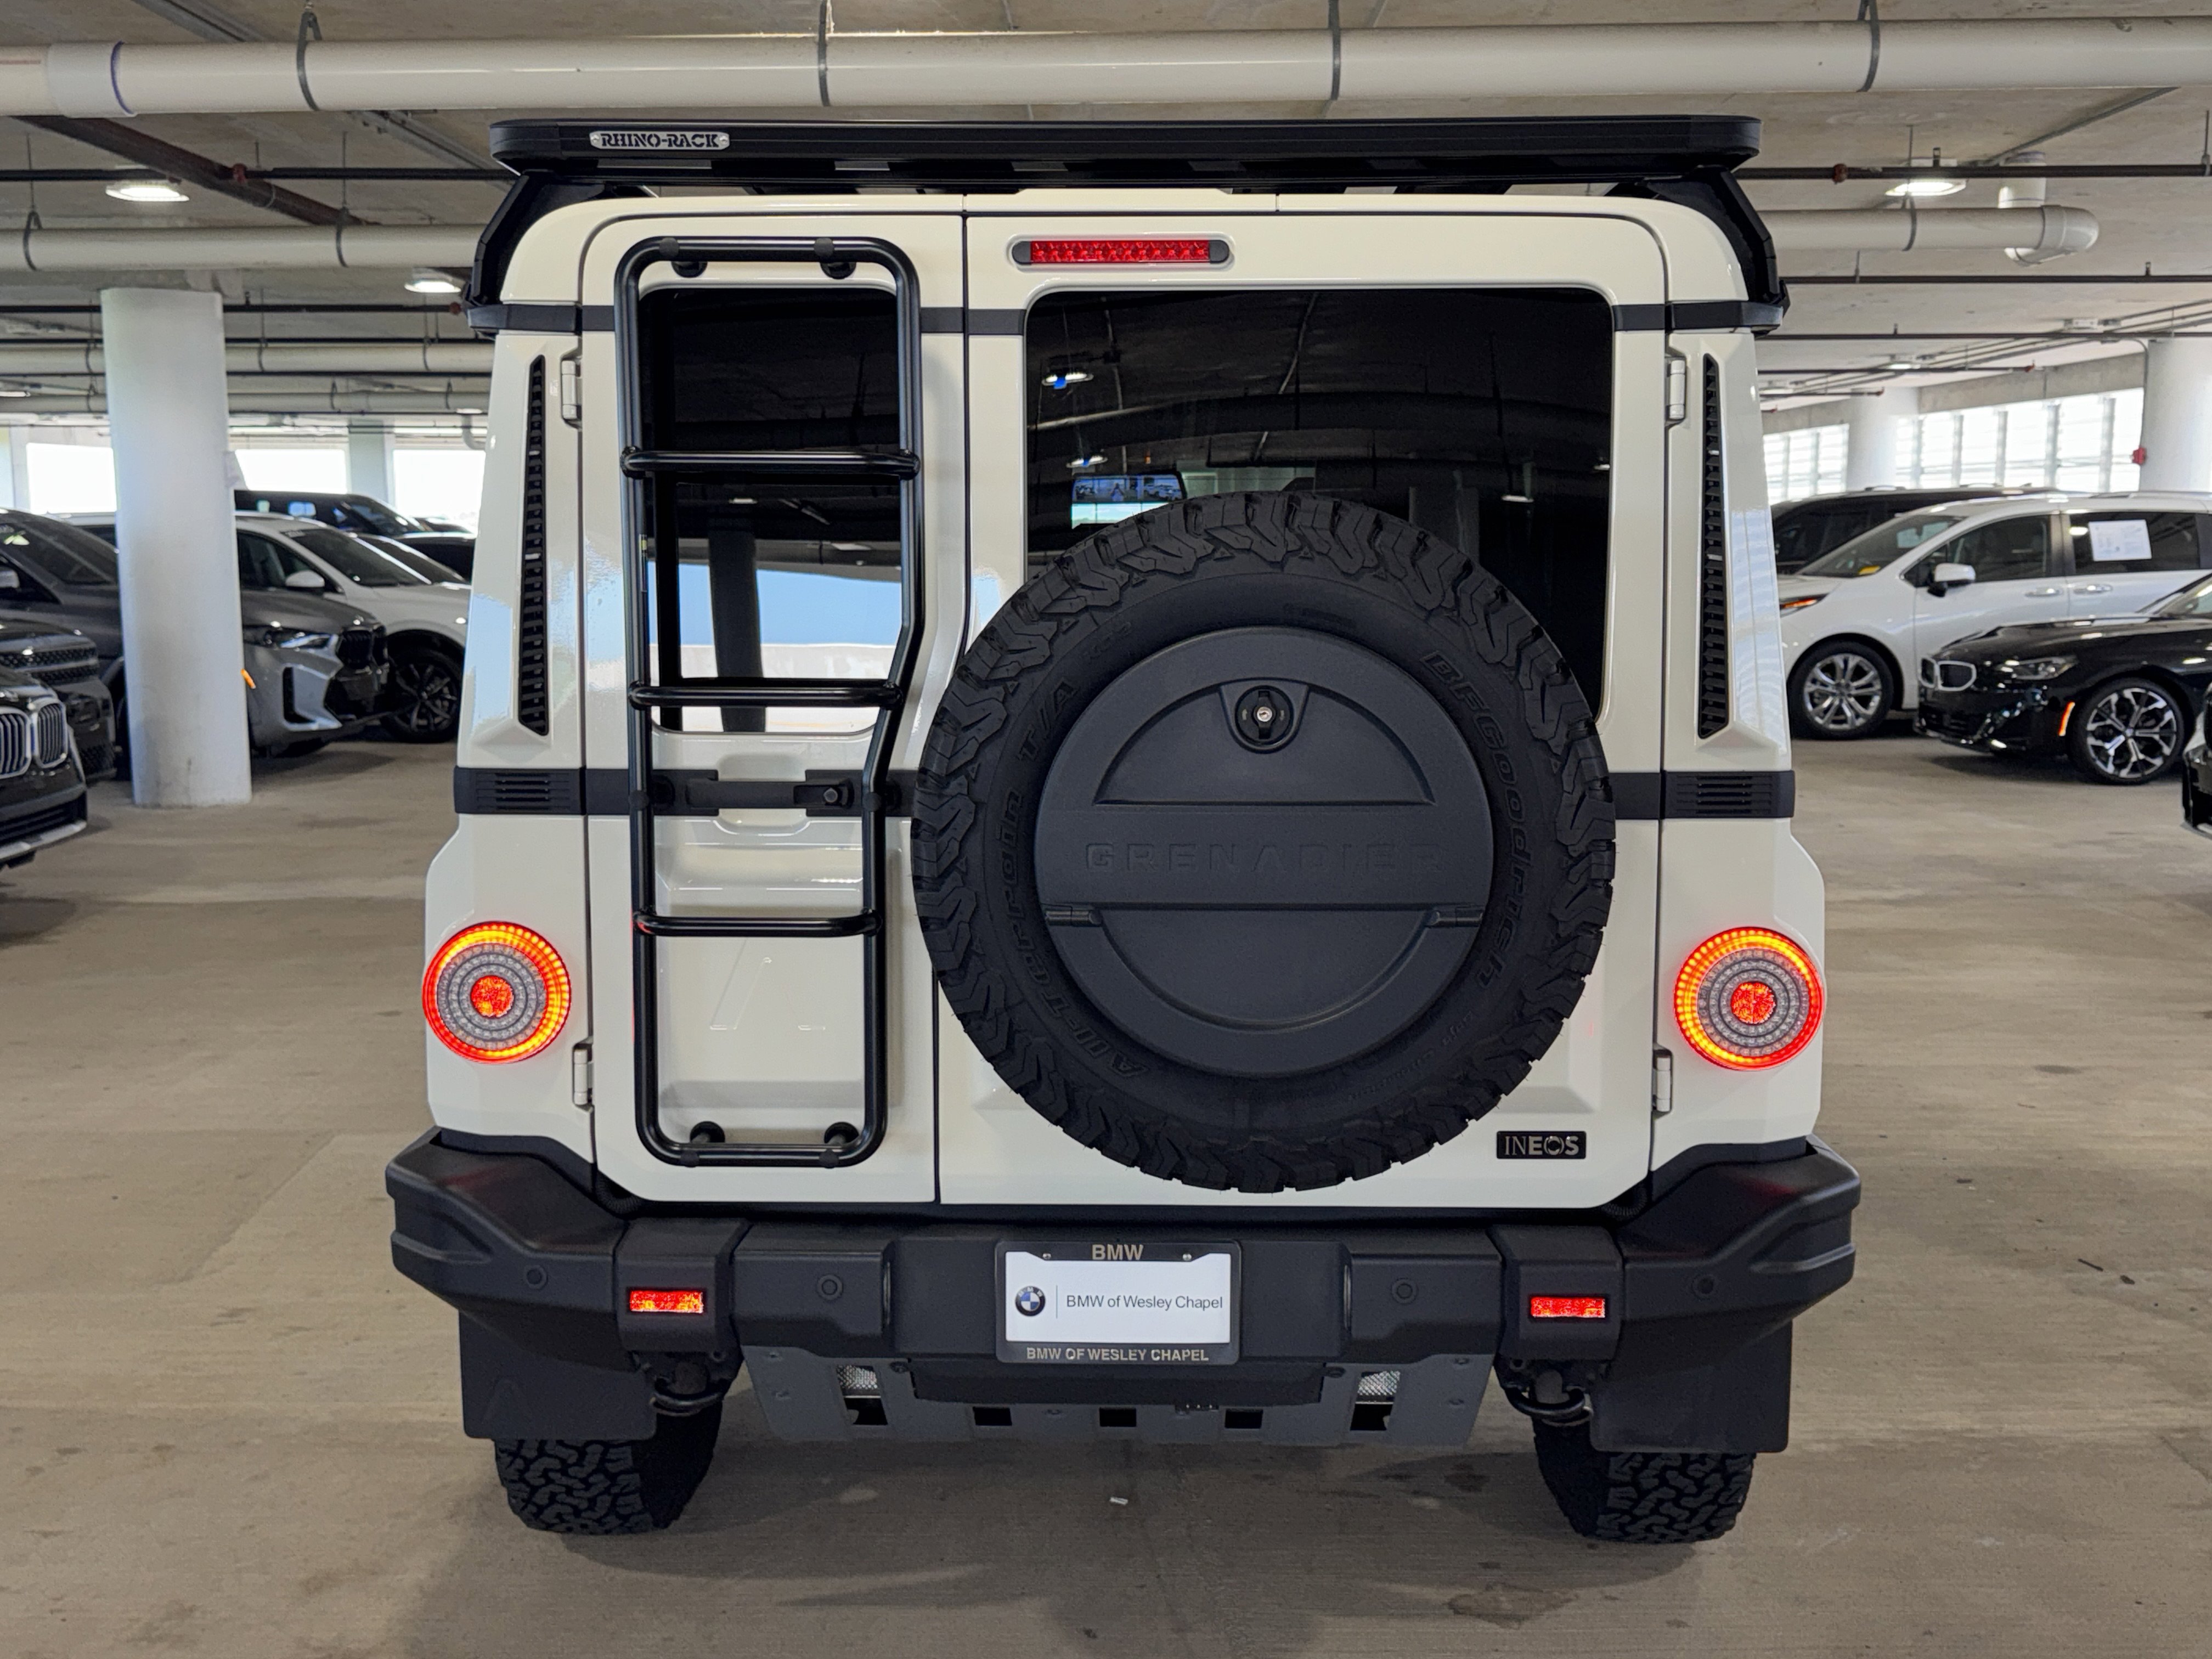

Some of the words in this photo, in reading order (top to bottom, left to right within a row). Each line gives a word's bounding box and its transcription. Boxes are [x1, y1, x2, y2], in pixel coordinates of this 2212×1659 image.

[600, 133, 719, 147] RHINO-RACK
[1017, 679, 1079, 761] T/A
[1419, 651, 1532, 987] BFGoodrich
[1085, 843, 1444, 872] GRENADIER
[1505, 1136, 1579, 1155] INEOS
[1092, 1244, 1144, 1261] BMW
[1066, 1295, 1104, 1308] BMW
[1107, 1295, 1121, 1308] of
[1124, 1295, 1172, 1311] Wesley
[1175, 1296, 1223, 1311] Chapel
[1026, 1347, 1062, 1360] BMW
[1066, 1347, 1085, 1361] OF
[1087, 1348, 1147, 1361] WESLEY
[1151, 1349, 1209, 1362] CHAPEL
